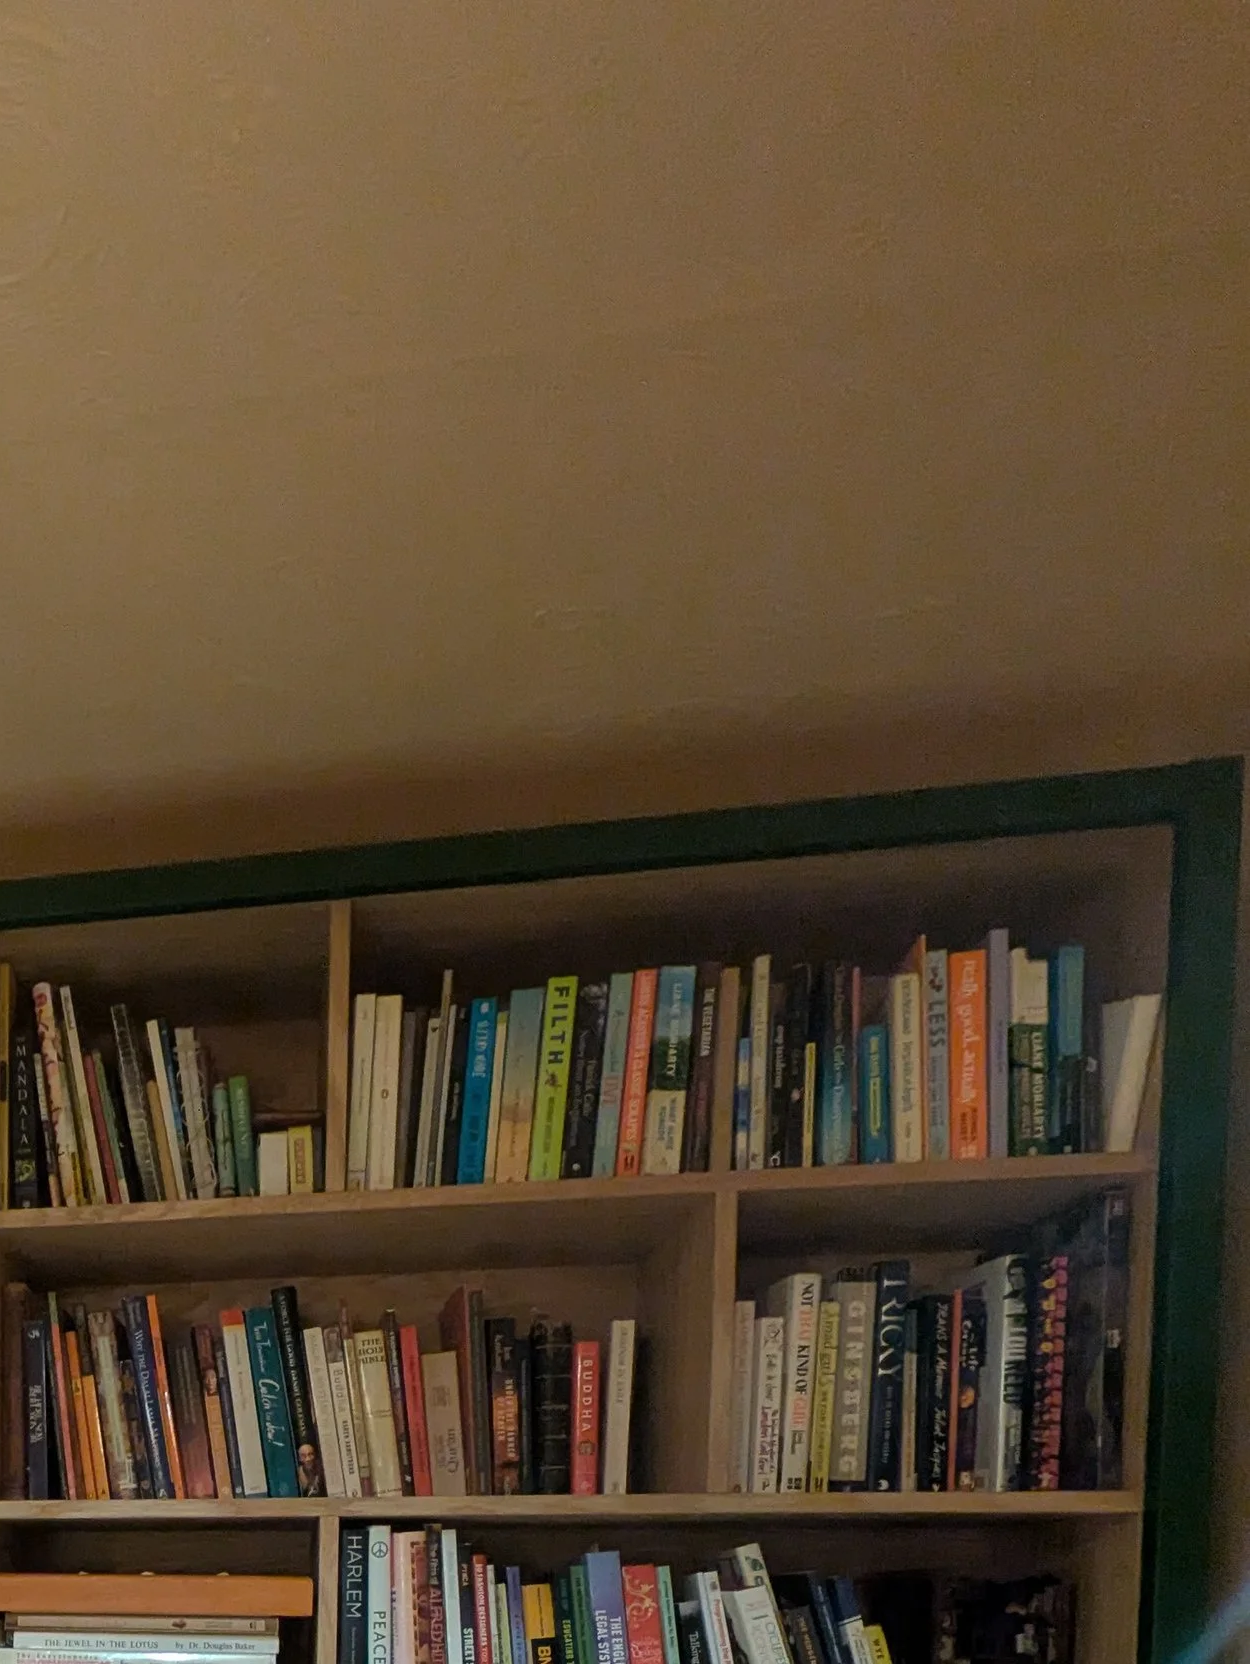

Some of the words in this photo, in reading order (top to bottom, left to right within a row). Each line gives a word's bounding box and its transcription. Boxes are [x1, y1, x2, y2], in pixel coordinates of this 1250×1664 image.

[703, 986, 713, 1004] THE
[548, 985, 569, 1065] FILTH
[700, 1006, 712, 1056] VEGETARIAN
[930, 1000, 945, 1047] LESS
[16, 1045, 28, 1144] MANDALA
[1033, 1074, 1043, 1139] MORIARTY
[800, 1282, 812, 1306] NOT
[876, 1277, 907, 1379] TRICKY
[795, 1344, 808, 1376] KIND
[580, 1359, 593, 1432] BUDDHA
[794, 1379, 806, 1395] OF
[837, 1299, 868, 1474] GINSBERG
[430, 1544, 438, 1558] The
[430, 1559, 438, 1576] Films
[347, 1535, 363, 1617] HARLEM
[461, 1564, 469, 1586] PYMCA
[476, 1574, 486, 1605] FASHION
[430, 1588, 447, 1639] ALFRED
[478, 1606, 488, 1646] DESIGNERS
[594, 1610, 607, 1640] LEGAL
[609, 1616, 622, 1635] THE
[711, 1598, 727, 1646] Programming
[721, 1647, 730, 1659] the
[45, 1639, 61, 1647] THE
[65, 1640, 92, 1648] JEWEL
[96, 1640, 106, 1648] IN
[130, 1641, 158, 1649] LOTUS
[175, 1641, 184, 1650] by
[203, 1641, 232, 1651] Douglas
[235, 1642, 255, 1650] Baker
[374, 1611, 386, 1664] PEACE
[463, 1628, 475, 1660] STREET
[562, 1619, 573, 1659] EDUCATING
[686, 1631, 702, 1664] Talking
[871, 1637, 884, 1660] WYE
[481, 1647, 489, 1663] YOU
